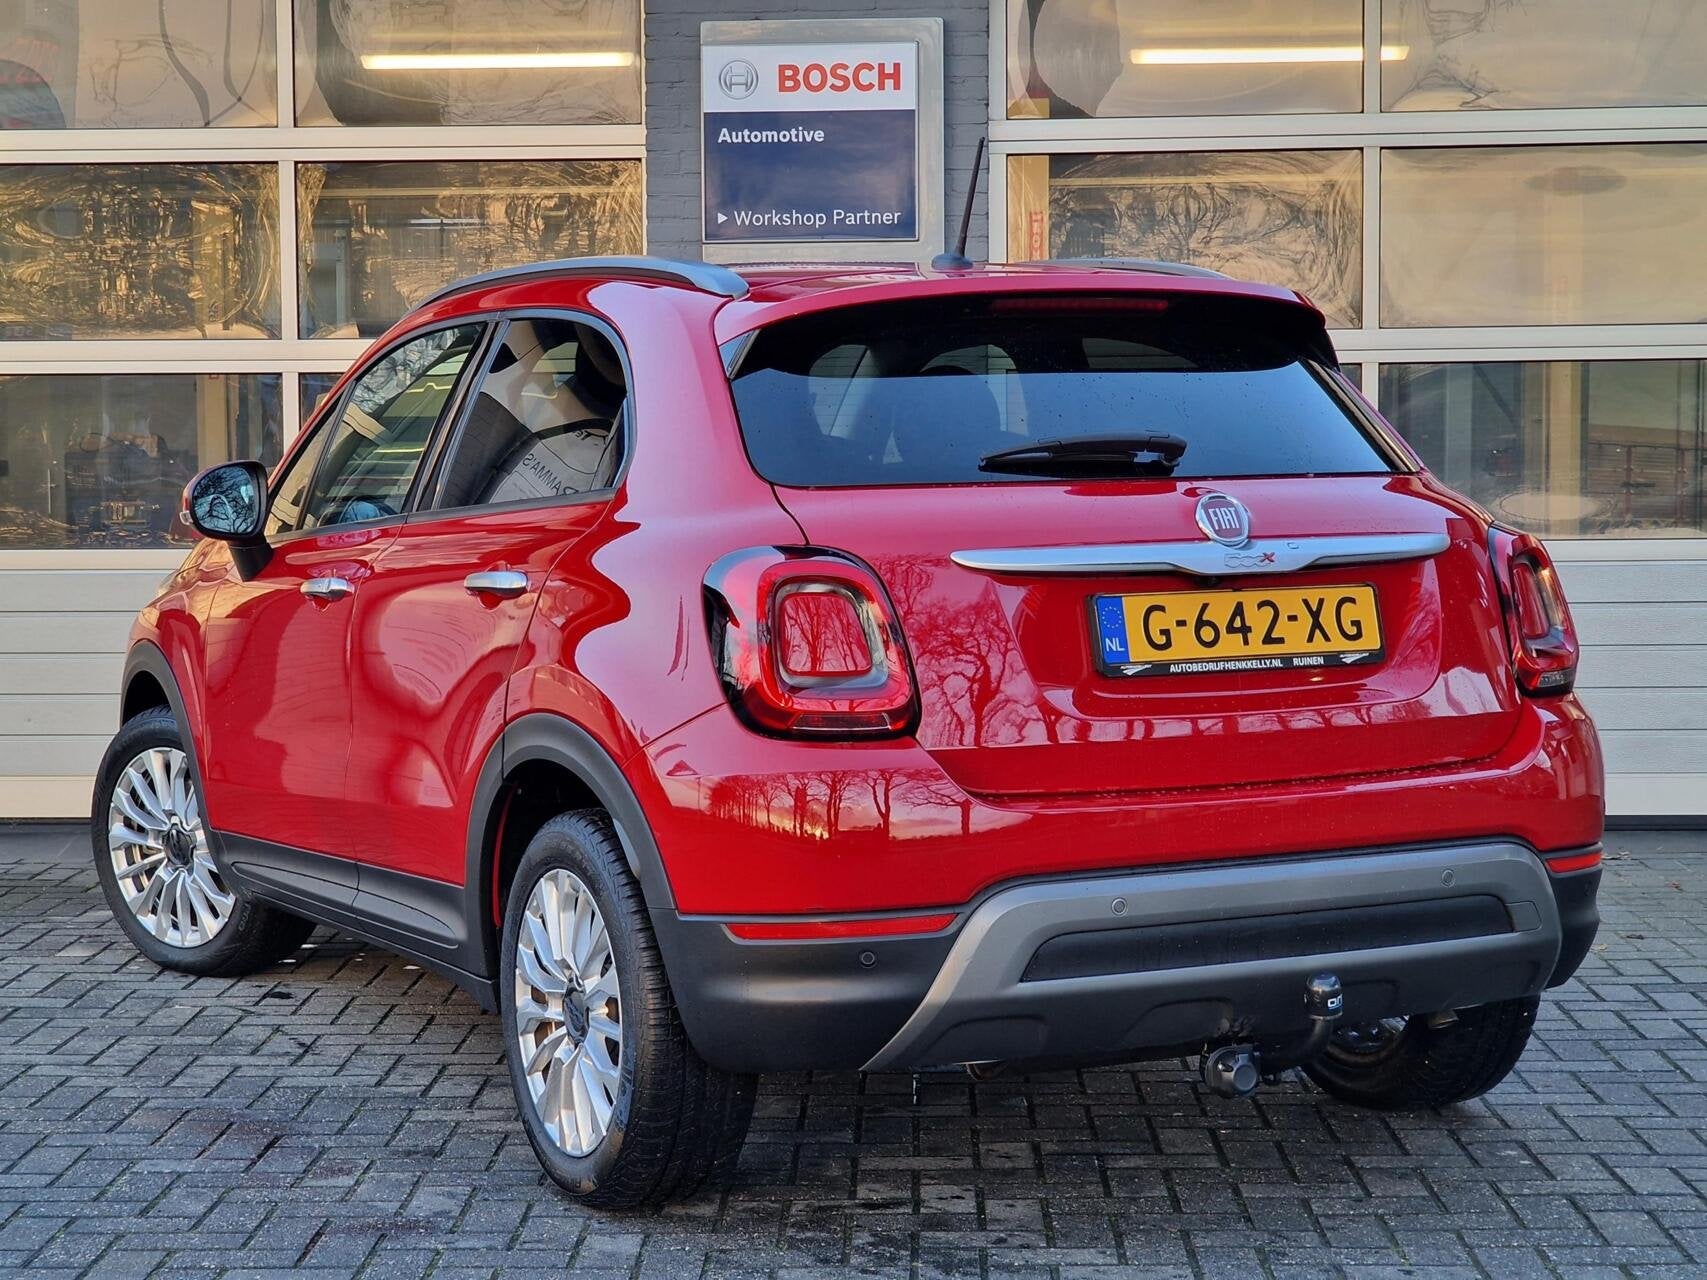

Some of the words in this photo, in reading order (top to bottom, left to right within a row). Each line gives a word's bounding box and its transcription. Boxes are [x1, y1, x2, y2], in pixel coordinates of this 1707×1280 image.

[778, 62, 901, 93] BOSCH
[717, 126, 825, 144] Automotive
[734, 210, 827, 229] Workshop
[833, 209, 901, 225] Partner
[1208, 507, 1239, 530] FIAT
[1142, 596, 1363, 651] G-642-XG
[1105, 637, 1125, 652] NL
[1169, 658, 1283, 673] AUTOBEDRIJFHENKKELLY.NL
[1293, 656, 1324, 666] RUINEN
